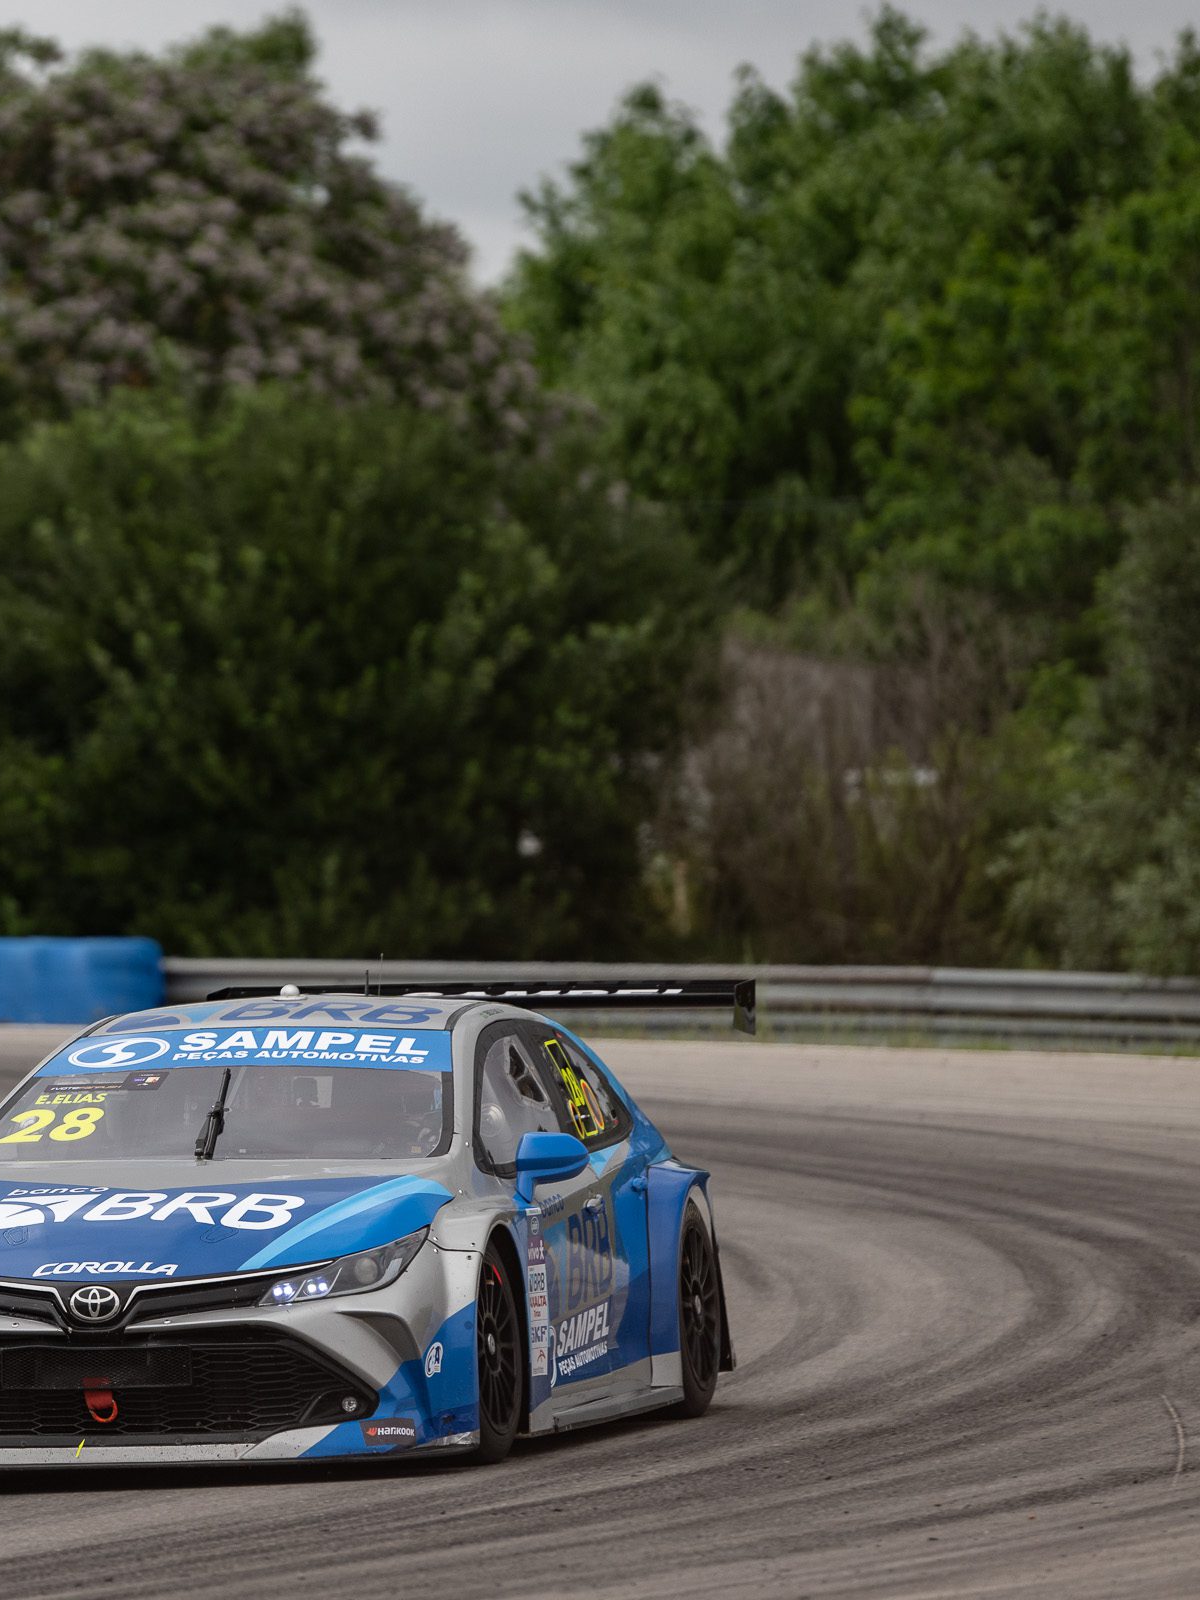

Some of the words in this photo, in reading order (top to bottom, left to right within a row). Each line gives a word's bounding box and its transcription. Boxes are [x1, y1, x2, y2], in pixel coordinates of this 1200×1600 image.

[220, 1003, 443, 1026] BRB
[178, 1030, 431, 1056] SAMPEL
[172, 1050, 249, 1062] PEÇAS
[254, 1051, 425, 1064] AUTOMOTIVAS
[35, 1093, 108, 1105] E.ELIAS
[7, 1186, 110, 1197] banco
[82, 1192, 306, 1231] BRB
[568, 1199, 612, 1310] BRB
[32, 1261, 179, 1278] COROLLA
[557, 1302, 610, 1357] SAMPEL
